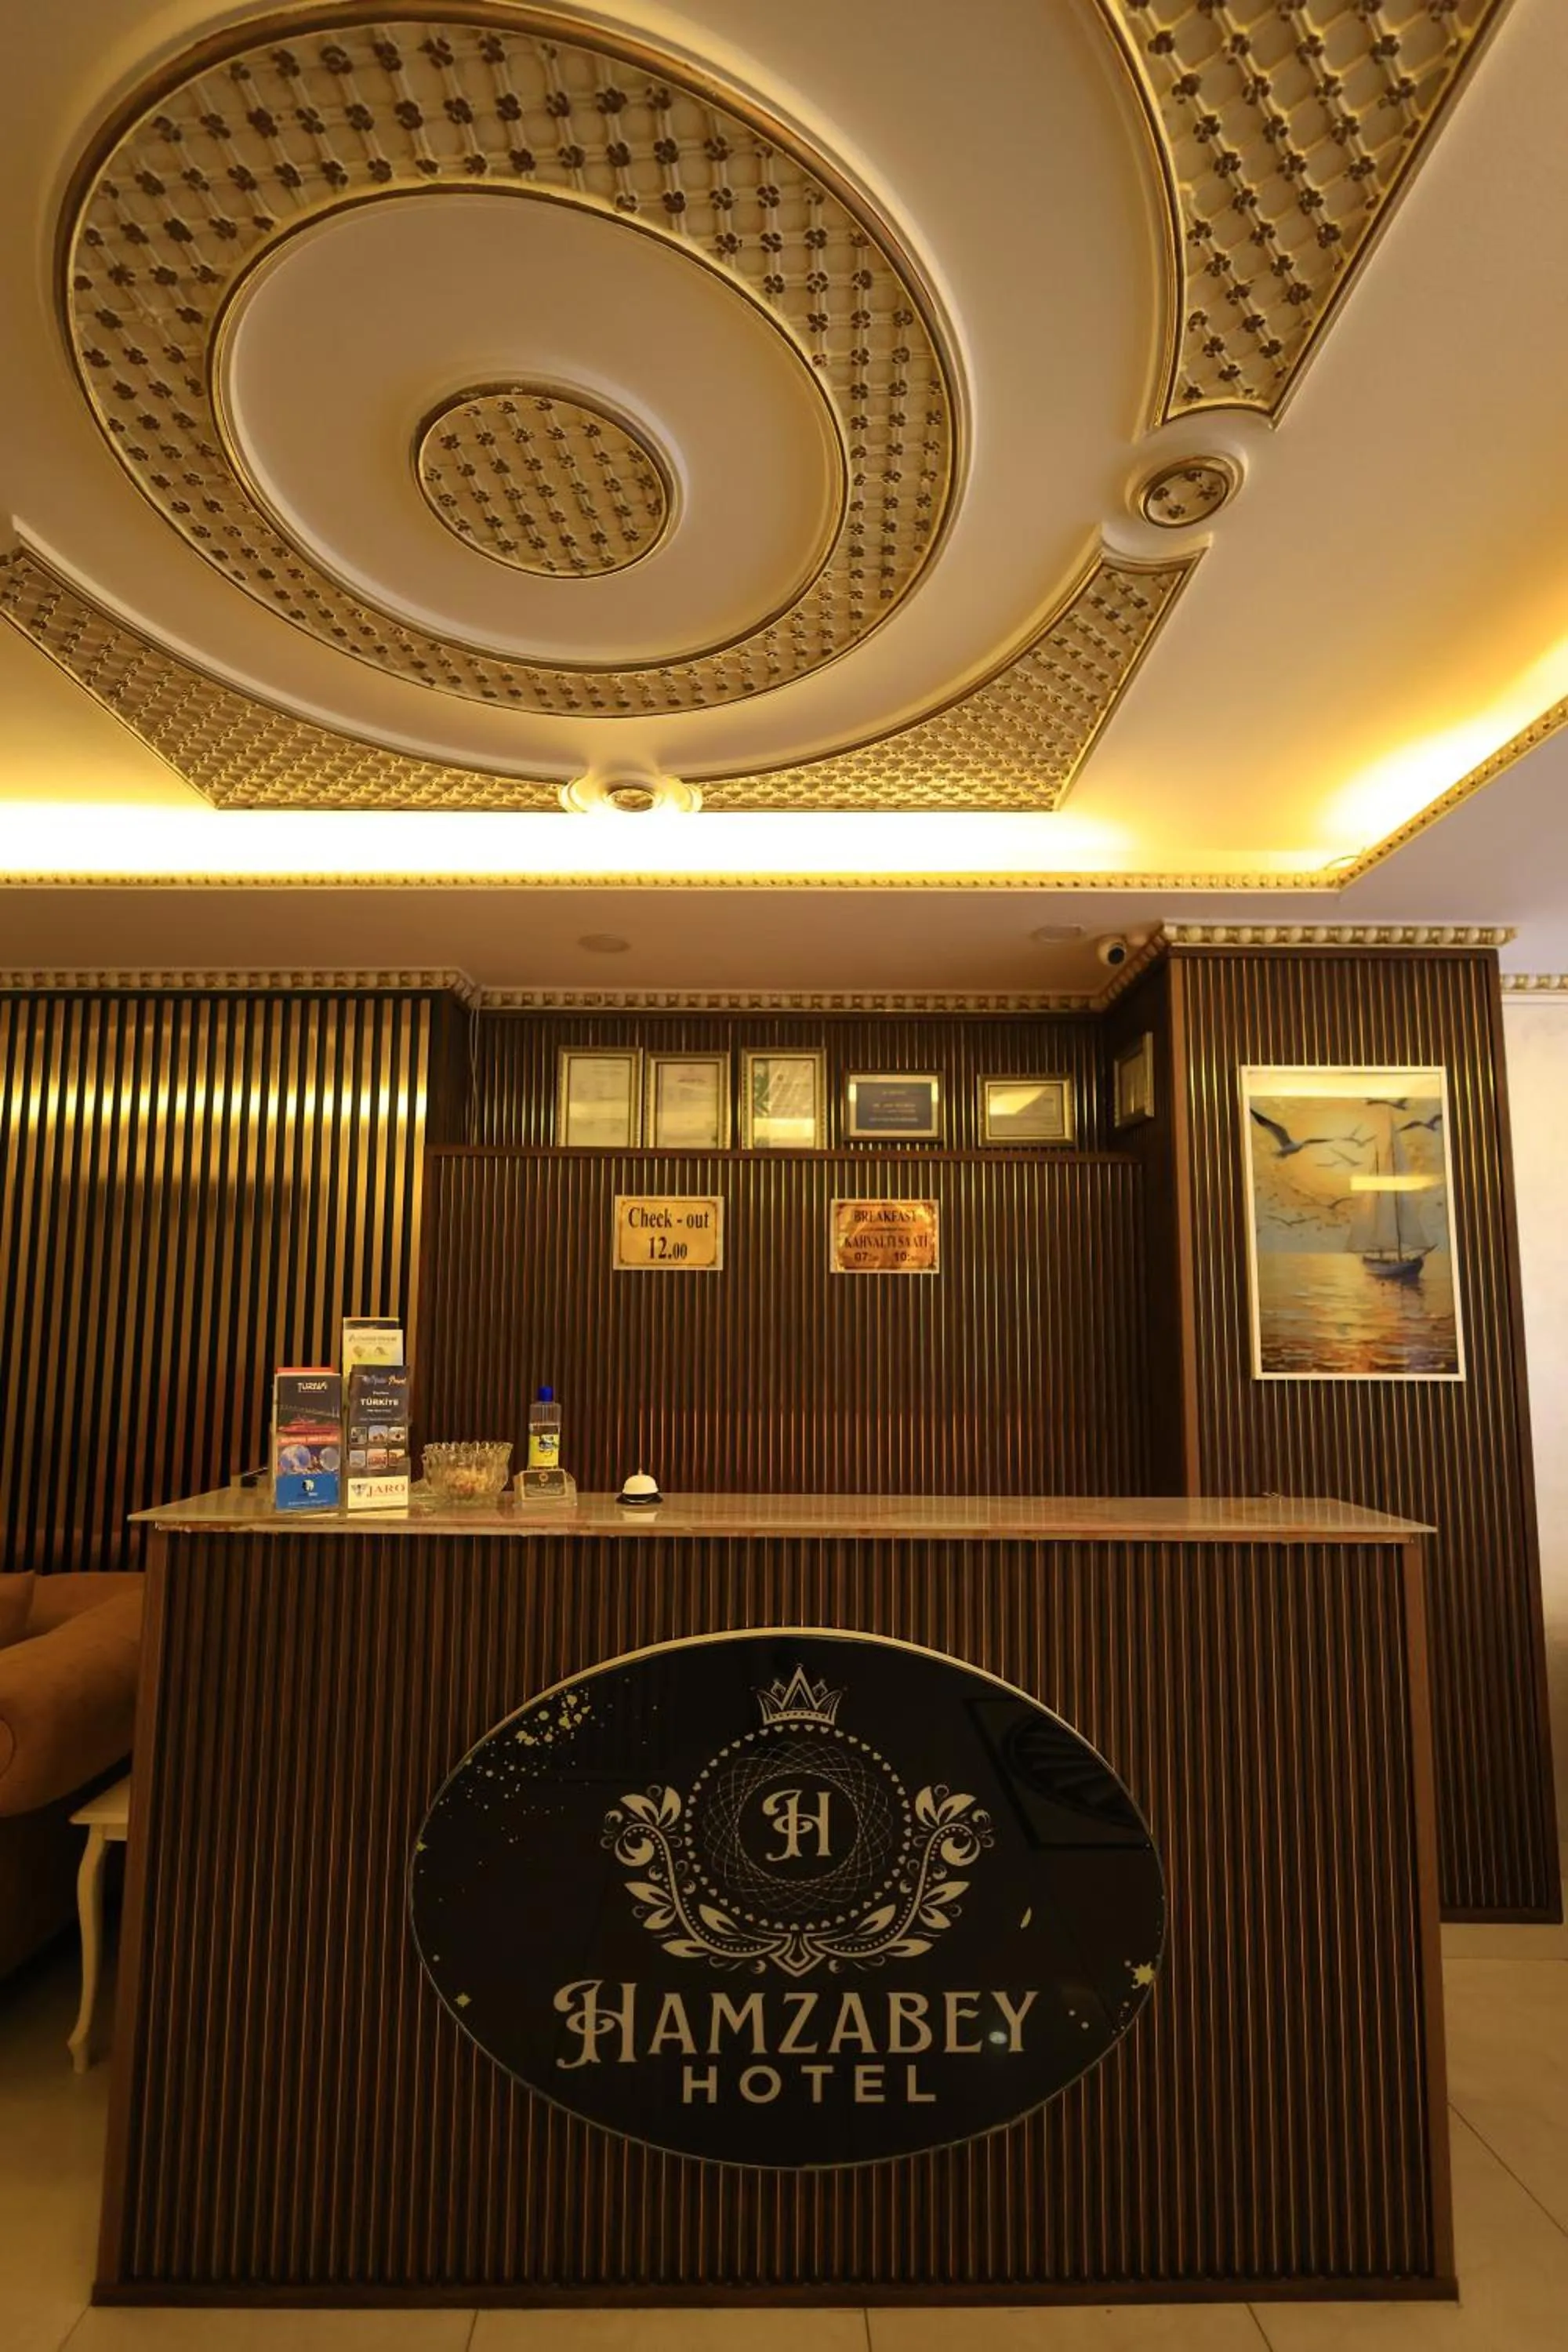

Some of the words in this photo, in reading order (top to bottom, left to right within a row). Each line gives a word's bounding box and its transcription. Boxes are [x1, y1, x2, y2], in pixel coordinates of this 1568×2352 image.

[628, 1207, 673, 1229] Check
[686, 1211, 709, 1229] out
[854, 1210, 916, 1222] BREAKFAST
[648, 1236, 688, 1259] 12.00
[553, 1979, 1040, 2069] HAMZABEY
[682, 2064, 937, 2103] HOTEL
